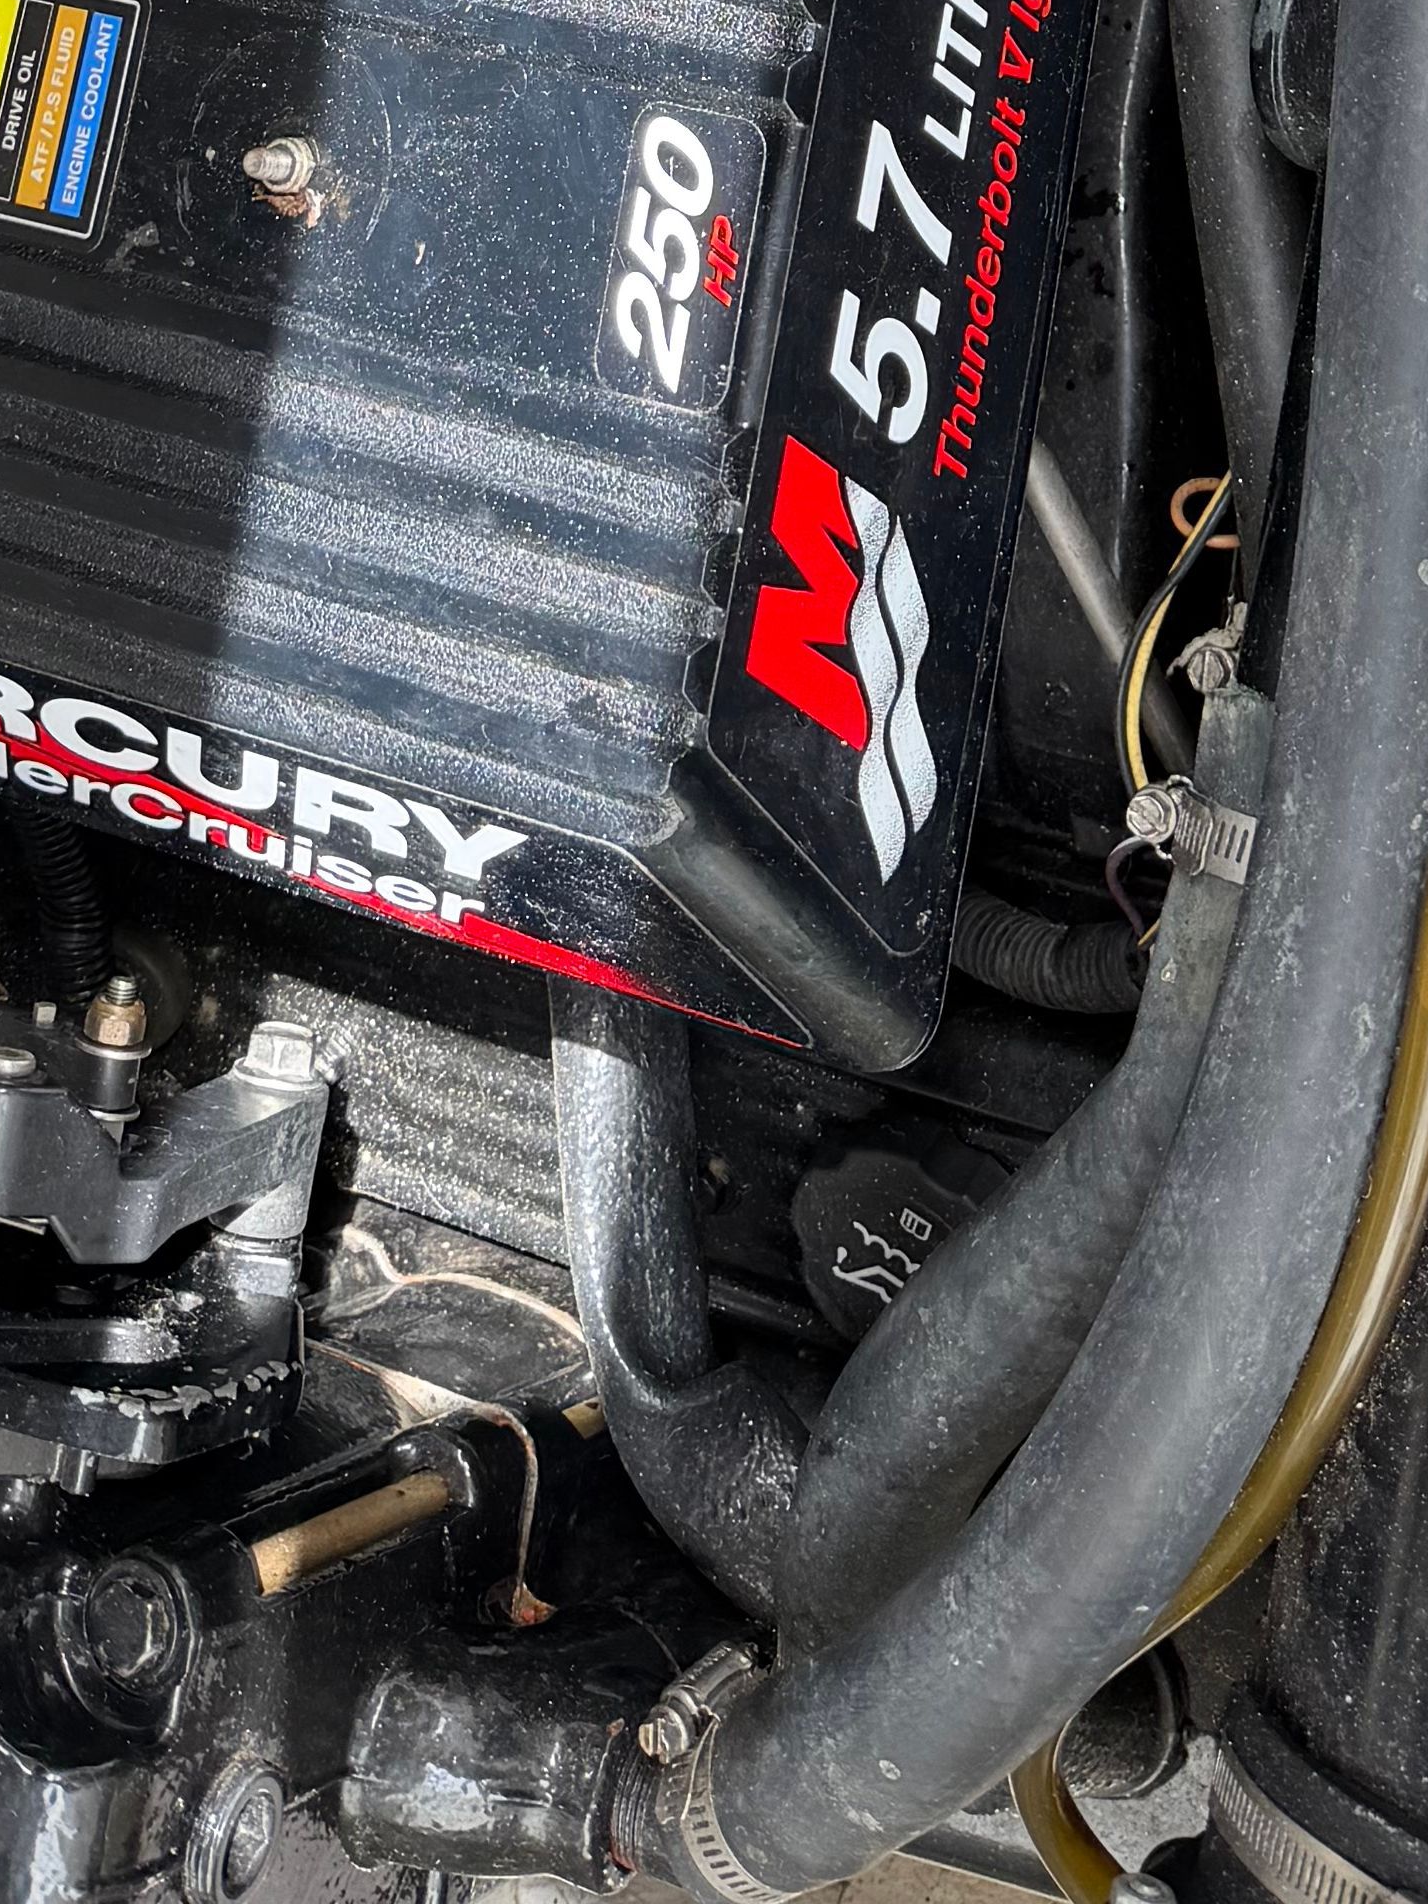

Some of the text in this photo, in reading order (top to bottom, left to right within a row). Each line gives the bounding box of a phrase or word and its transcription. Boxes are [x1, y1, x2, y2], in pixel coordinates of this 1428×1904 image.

[0, 47, 36, 150] DRIVE OIL
[50, 25, 76, 87] FLUID
[41, 90, 62, 126] P.S
[62, 17, 114, 204] ENGINE COOLANT
[28, 140, 51, 183] ATF
[614, 115, 716, 395] 250
[704, 215, 742, 310] HP
[834, 119, 950, 447] 5.7
[934, 100, 1032, 480] Thunderbolt
[996, 53, 1036, 84] V
